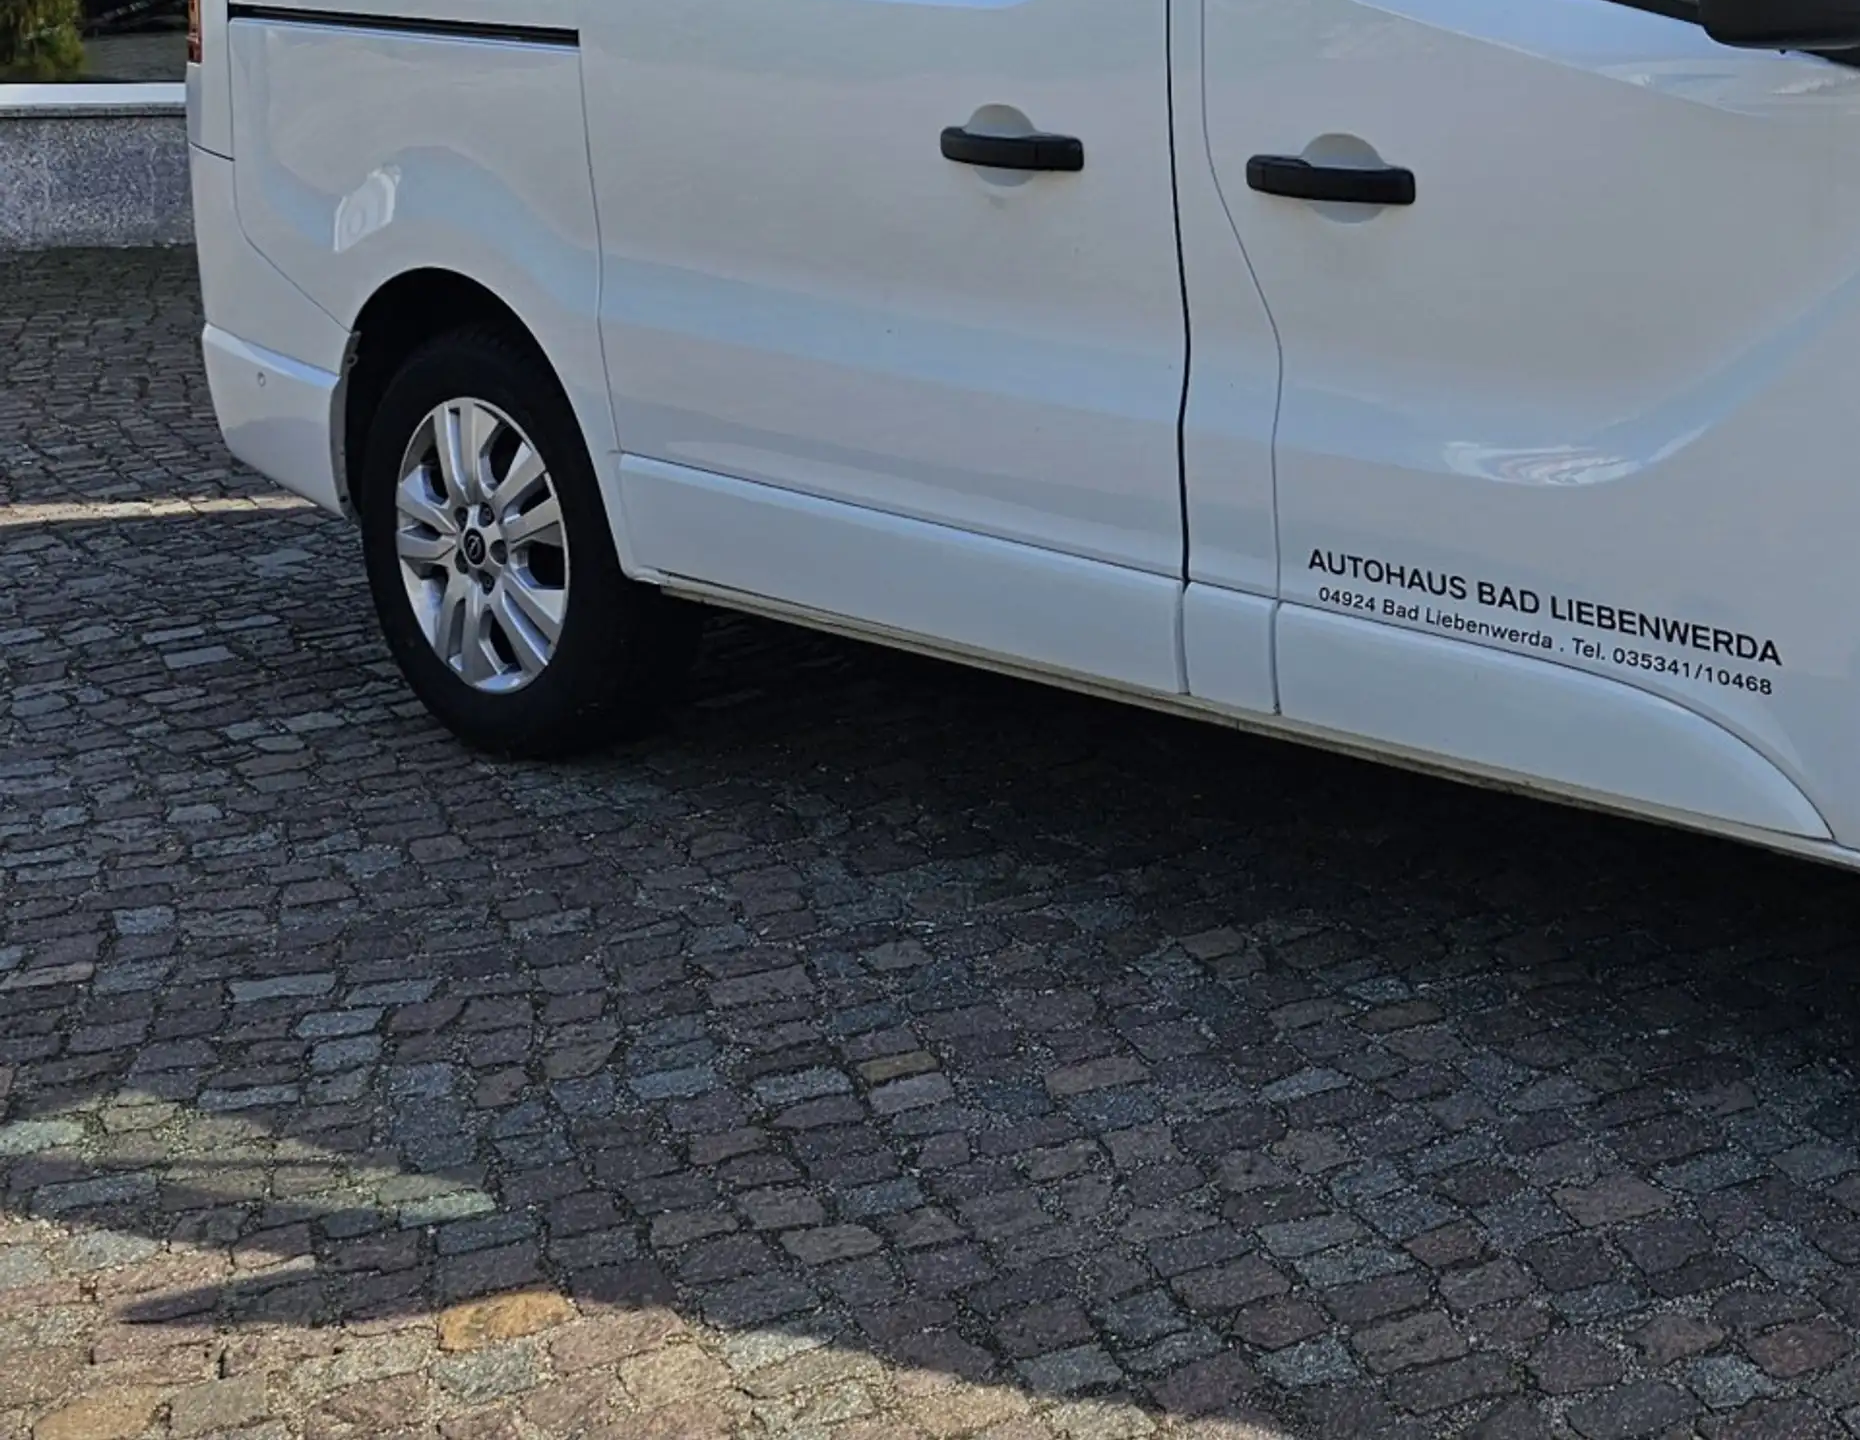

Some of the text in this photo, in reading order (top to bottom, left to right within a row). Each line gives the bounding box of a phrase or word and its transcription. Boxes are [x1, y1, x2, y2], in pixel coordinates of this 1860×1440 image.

[1308, 548, 1783, 667] AUTOHAUS BAD LIEBENWERDA
[1318, 586, 1376, 612] 04924
[1382, 598, 1420, 622] Bad
[1425, 607, 1553, 651] Liebenwerda
[1571, 637, 1607, 661] Tel.
[1612, 647, 1773, 696] 035341/10468
